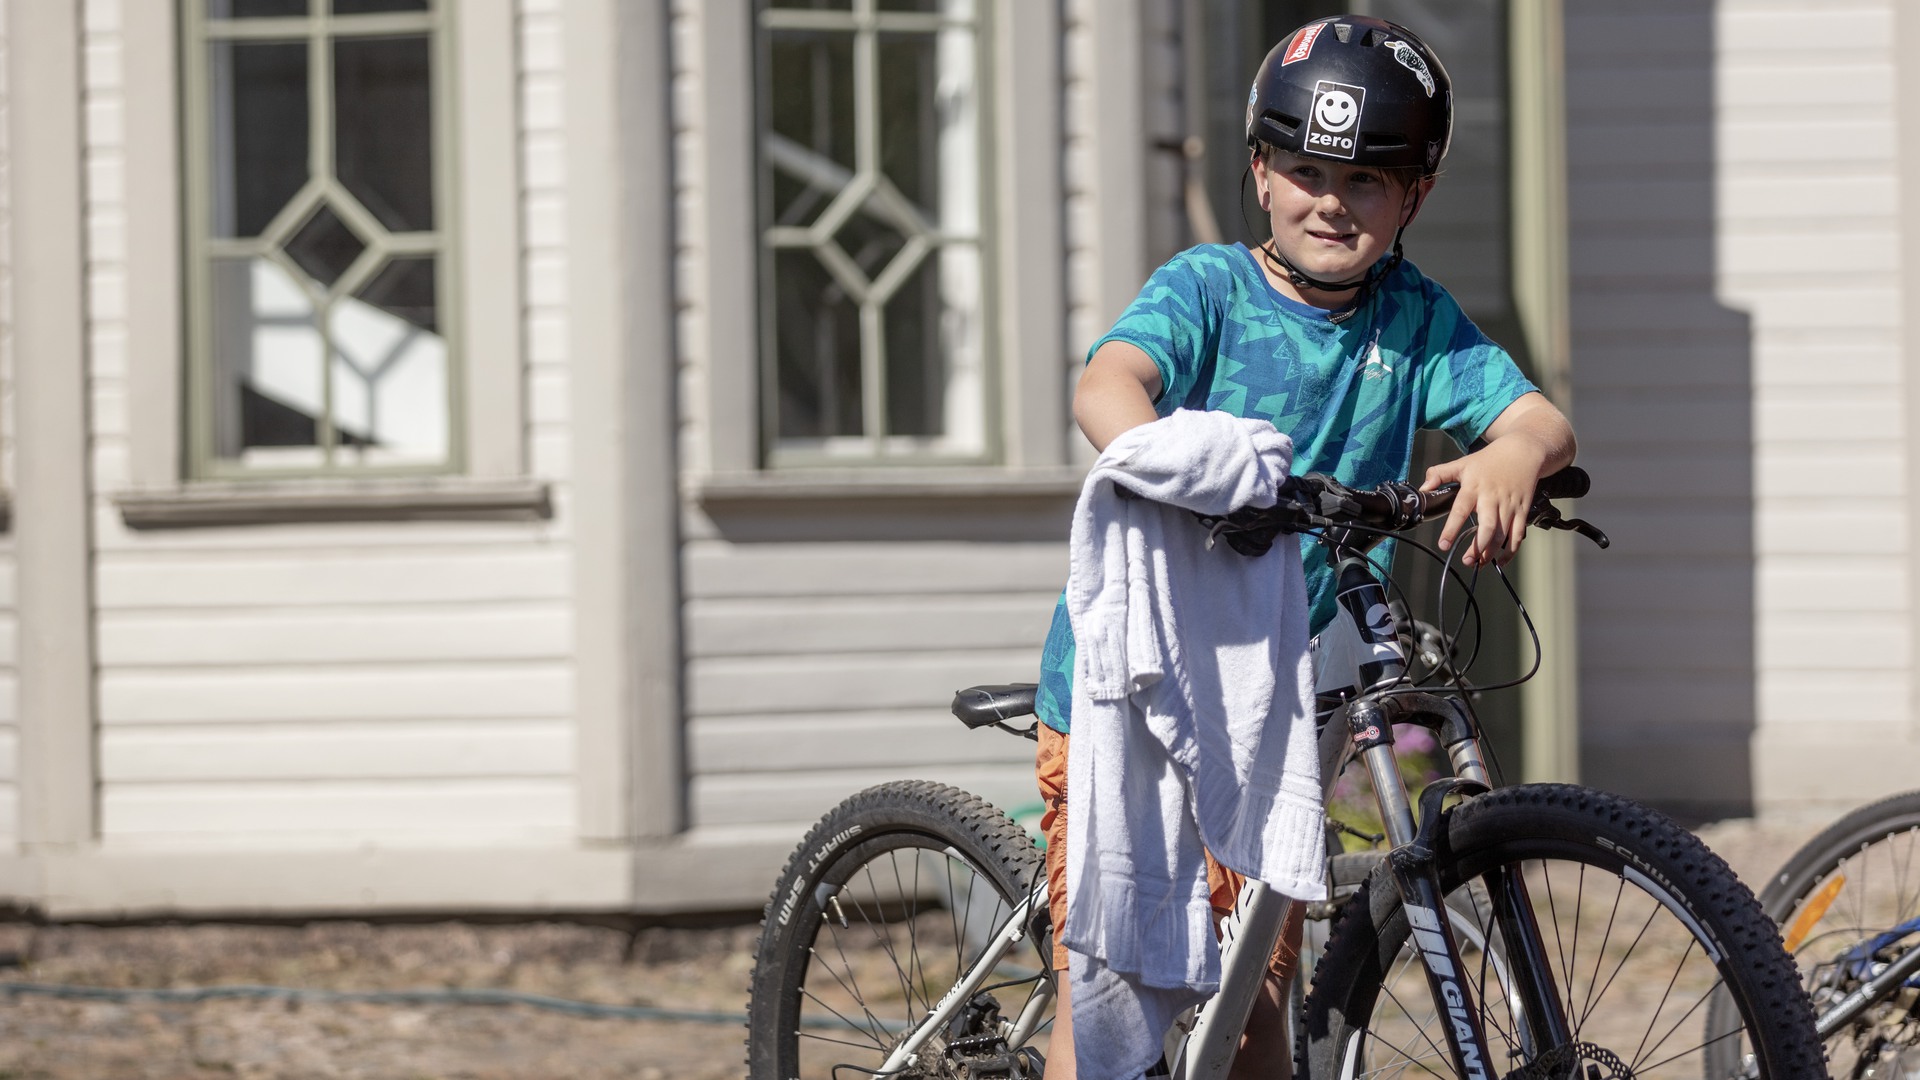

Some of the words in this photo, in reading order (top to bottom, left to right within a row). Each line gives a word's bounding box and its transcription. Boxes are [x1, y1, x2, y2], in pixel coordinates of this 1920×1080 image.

[1309, 132, 1353, 149] zero
[808, 824, 862, 874] SMART
[778, 874, 806, 926] SAM
[935, 976, 963, 1011] GIANT
